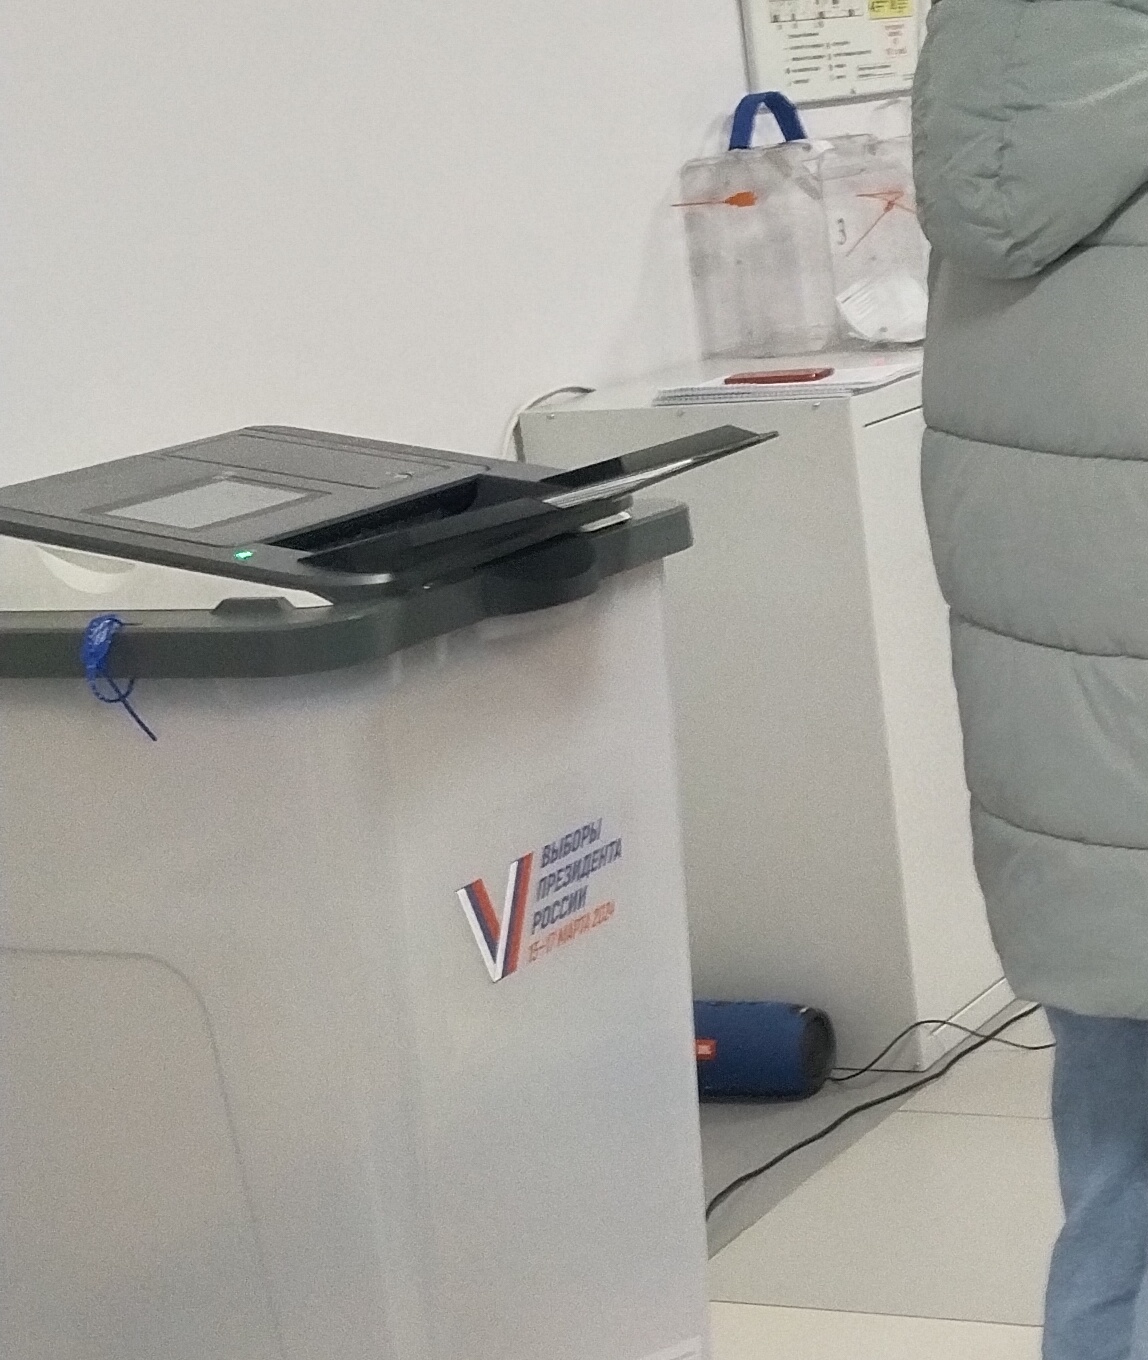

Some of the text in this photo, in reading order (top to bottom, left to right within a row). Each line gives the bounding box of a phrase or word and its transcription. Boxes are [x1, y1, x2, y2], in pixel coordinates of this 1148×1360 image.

[541, 818, 603, 869] ВЫБОРЫ
[536, 838, 622, 902] ПРЕЗИДЕНТА
[531, 885, 588, 935] РОССИИ
